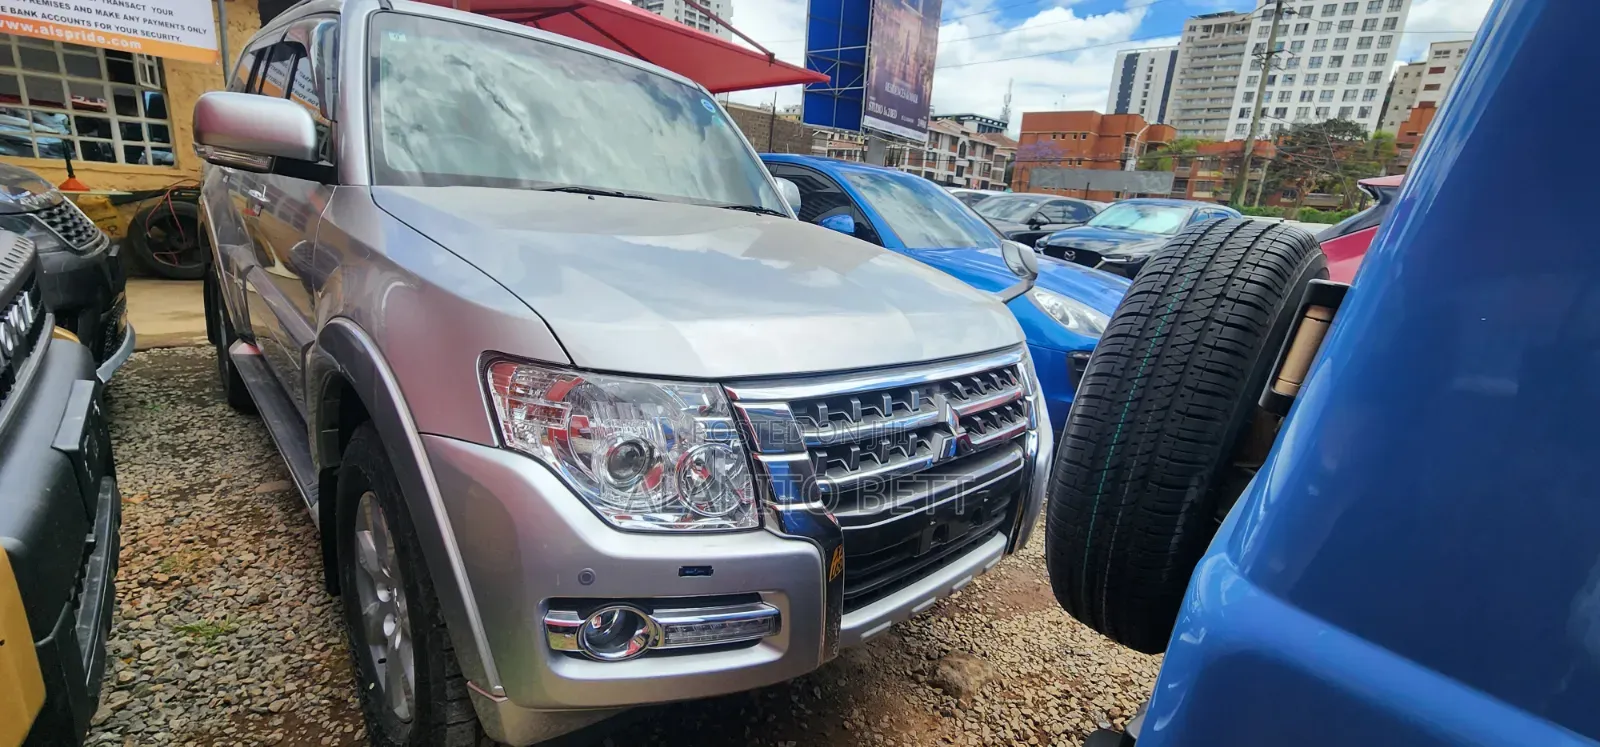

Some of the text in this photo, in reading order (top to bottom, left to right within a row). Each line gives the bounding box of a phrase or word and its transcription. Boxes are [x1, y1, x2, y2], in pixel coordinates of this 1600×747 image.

[9, 7, 38, 17] BANK
[41, 12, 92, 27] ACCOUNTS
[94, 21, 112, 31] FOR
[114, 25, 138, 35] YOUR
[140, 30, 183, 42] SECURITY.
[22, 0, 207, 35] REMISES AND MAKE ANY PAYMENTS ONLY
[151, 7, 174, 16] YOUR
